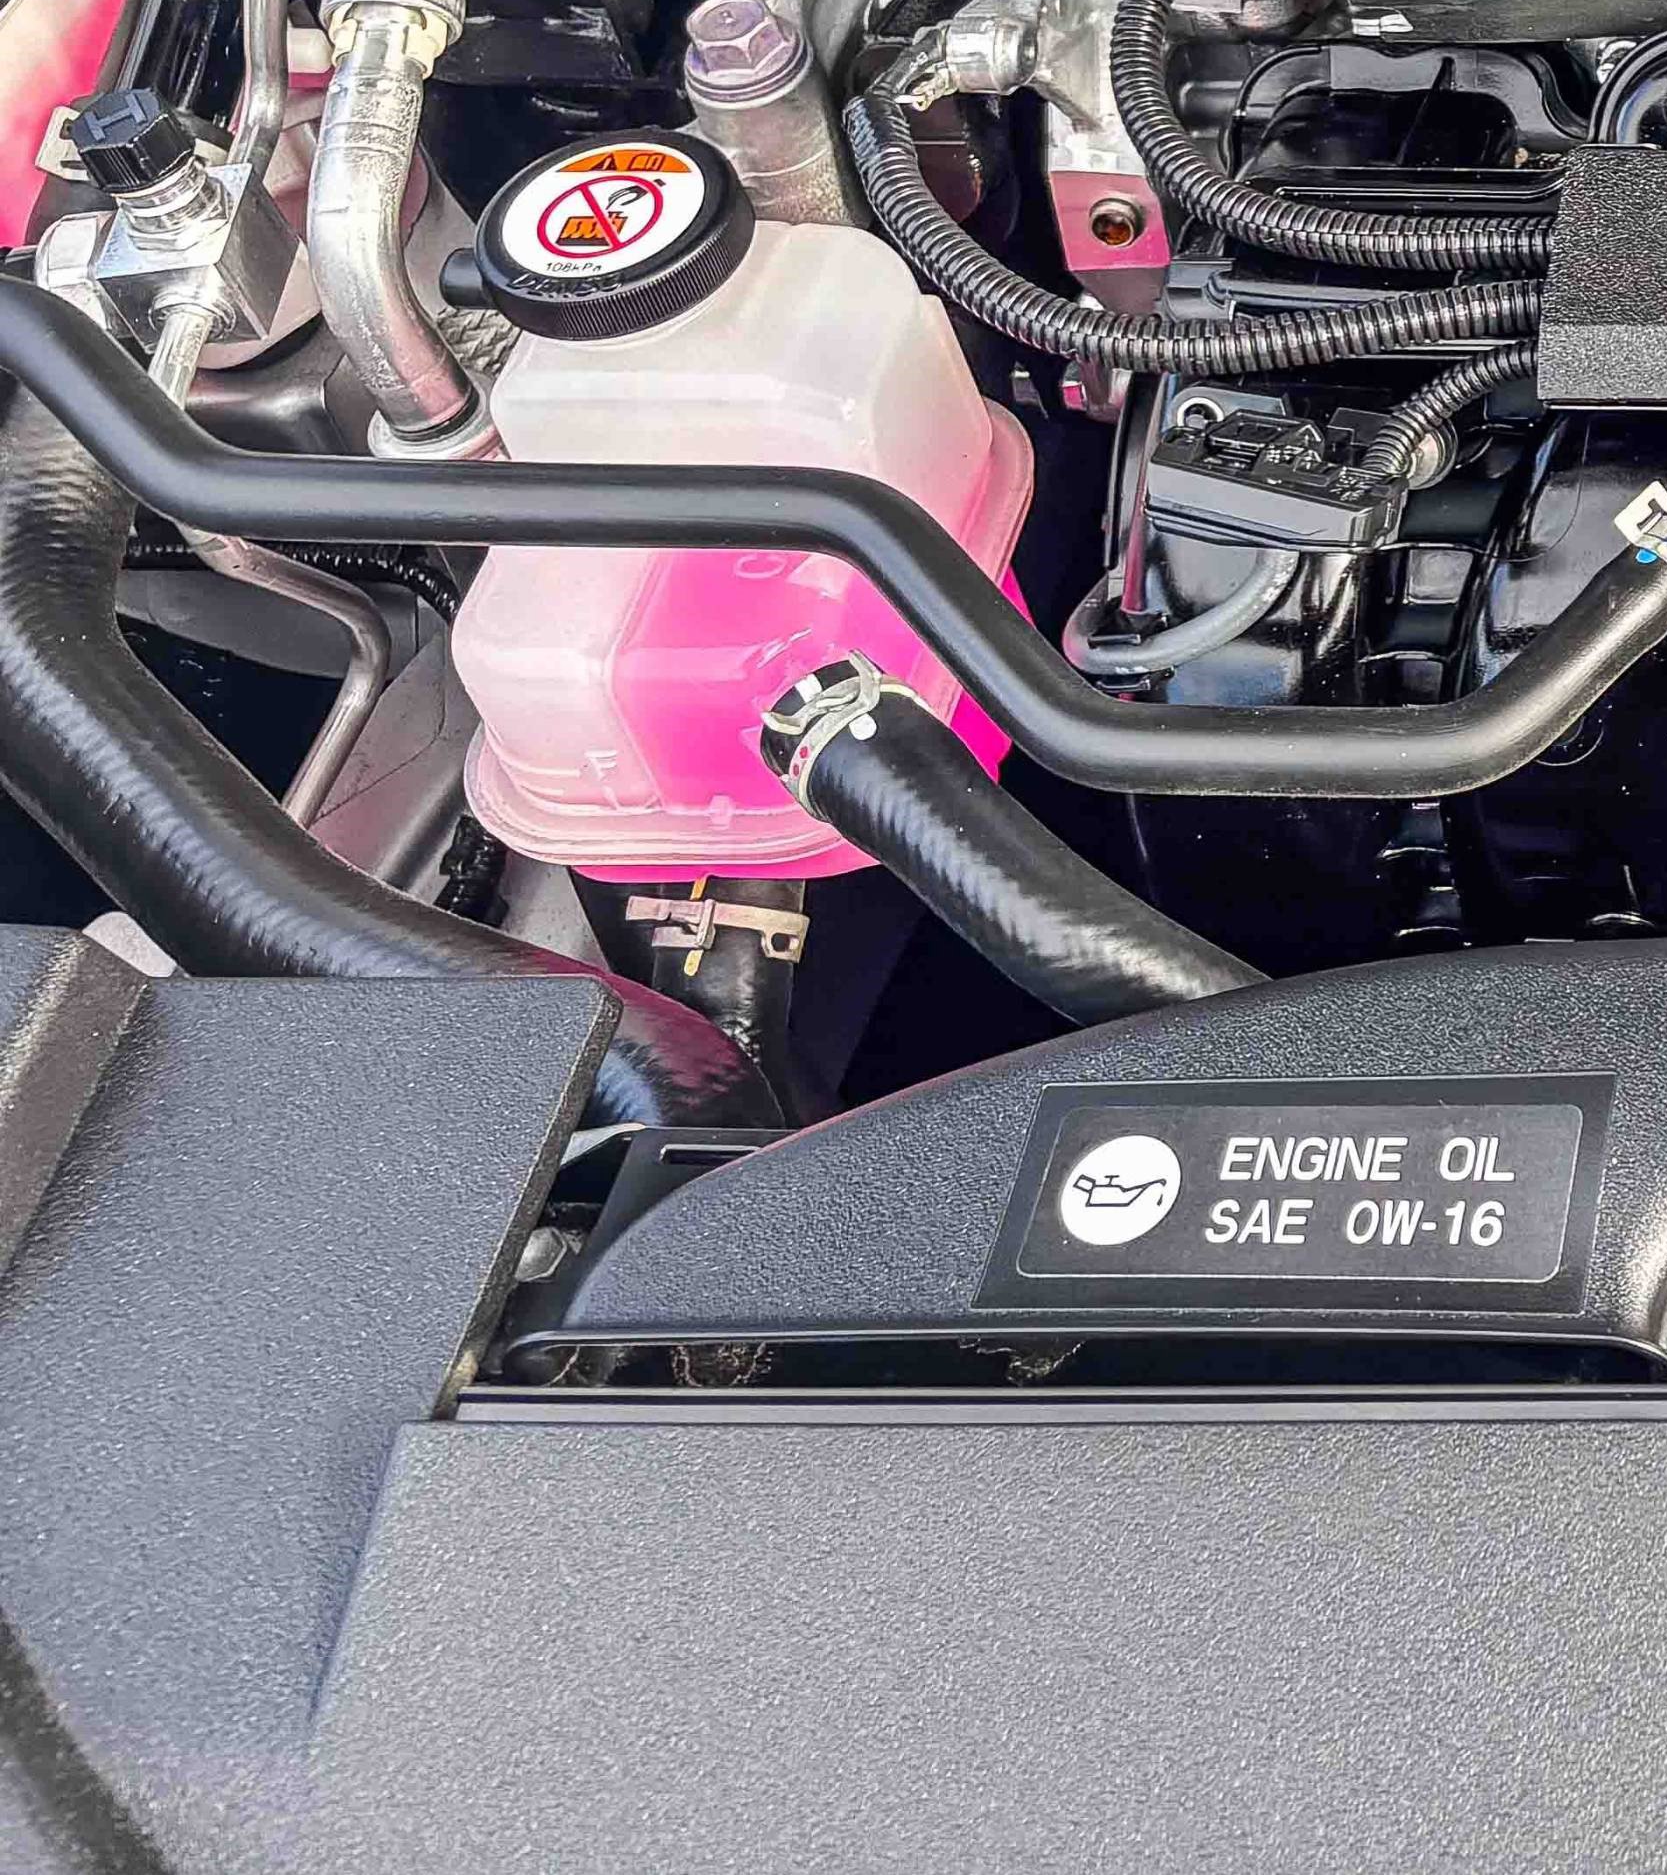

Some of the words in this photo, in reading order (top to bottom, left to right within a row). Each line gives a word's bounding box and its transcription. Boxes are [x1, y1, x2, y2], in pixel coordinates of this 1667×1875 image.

[84, 92, 148, 142] H
[1219, 1135, 1409, 1181] ENGINE
[1438, 1136, 1516, 1182] OIL
[1204, 1198, 1315, 1245] SAE
[1345, 1199, 1506, 1247] 0W-16
